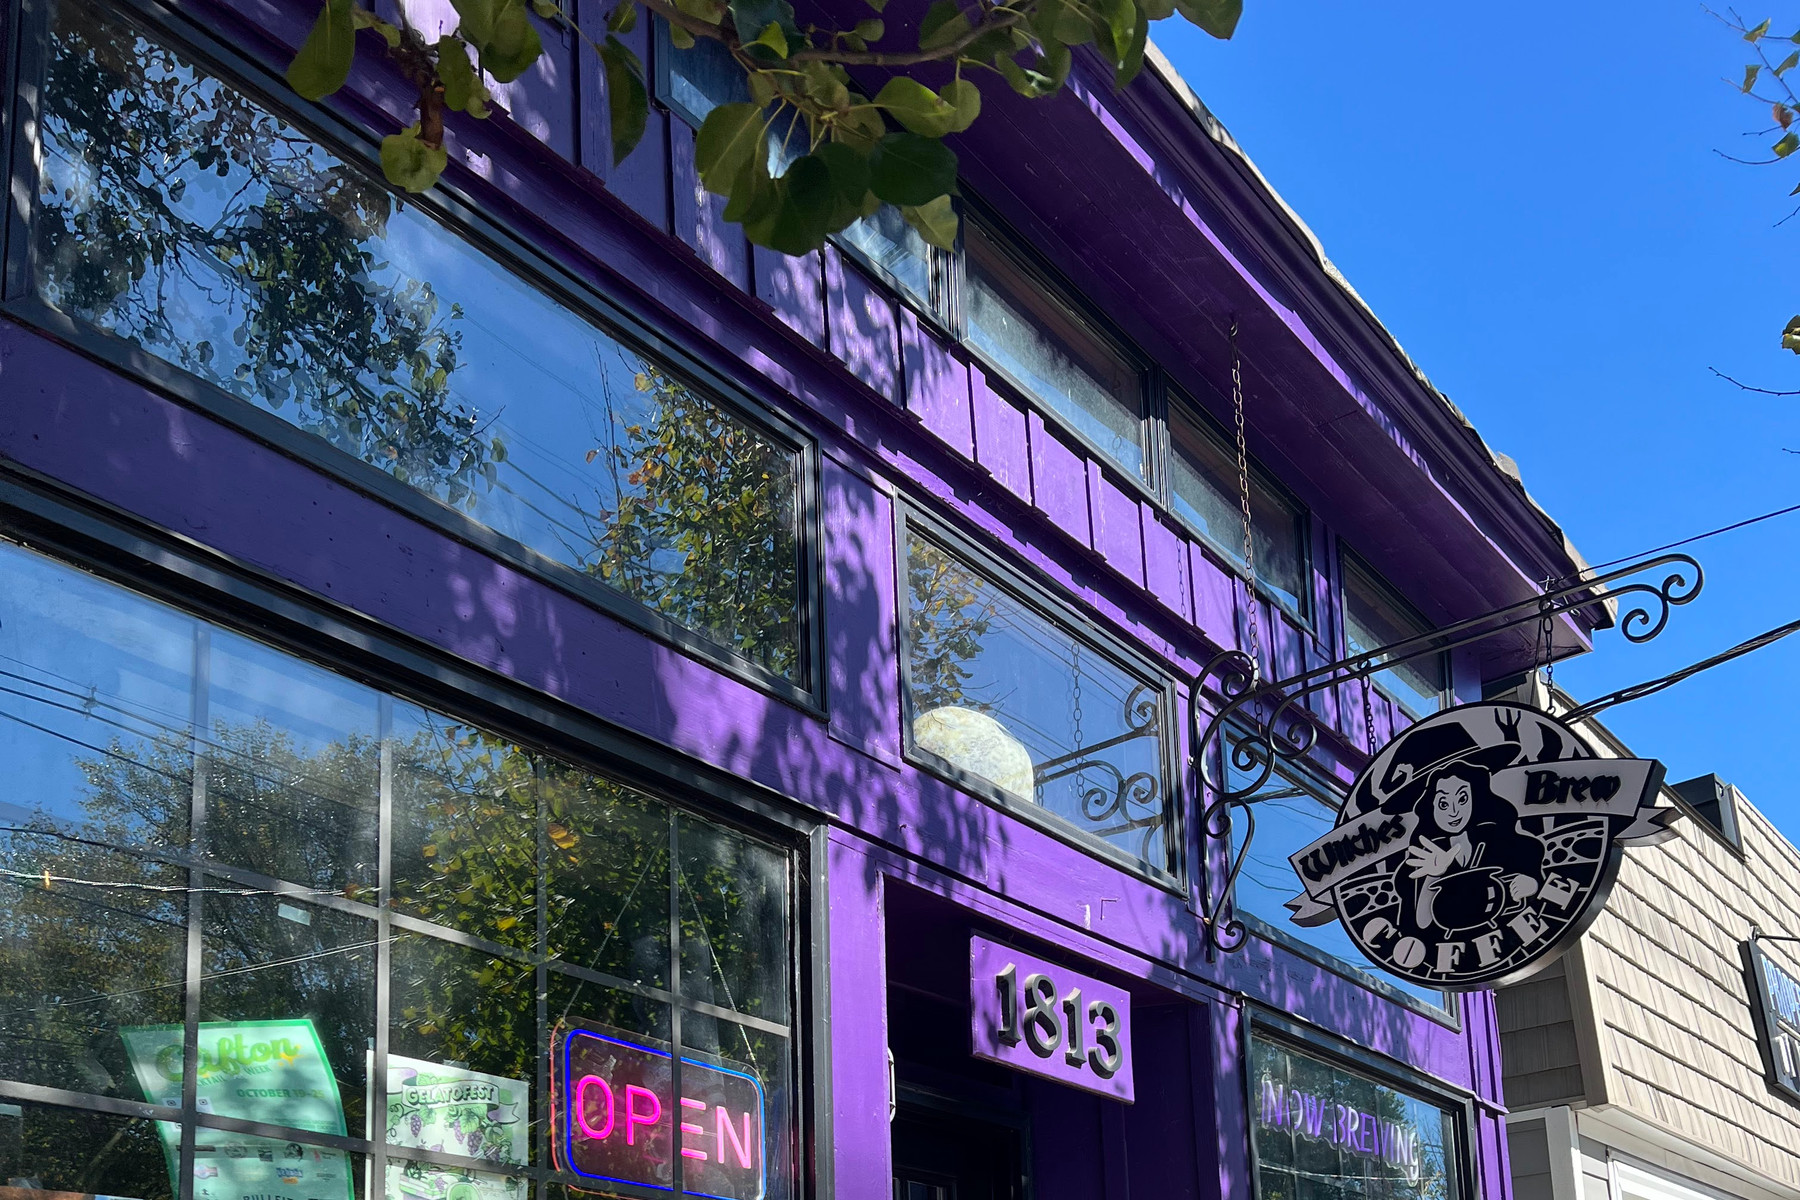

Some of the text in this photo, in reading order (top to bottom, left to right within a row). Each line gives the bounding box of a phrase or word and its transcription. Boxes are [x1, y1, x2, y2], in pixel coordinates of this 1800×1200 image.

[1524, 769, 1620, 807] Brew
[1299, 812, 1407, 883] Witches
[1363, 873, 1580, 974] COFFEE
[996, 961, 1124, 1079] 1813
[237, 1089, 290, 1099] OCTOBER
[406, 1085, 494, 1105] GELATOFEST
[575, 1073, 752, 1169] OPEN
[1261, 1080, 1419, 1182] NOW BREWING
